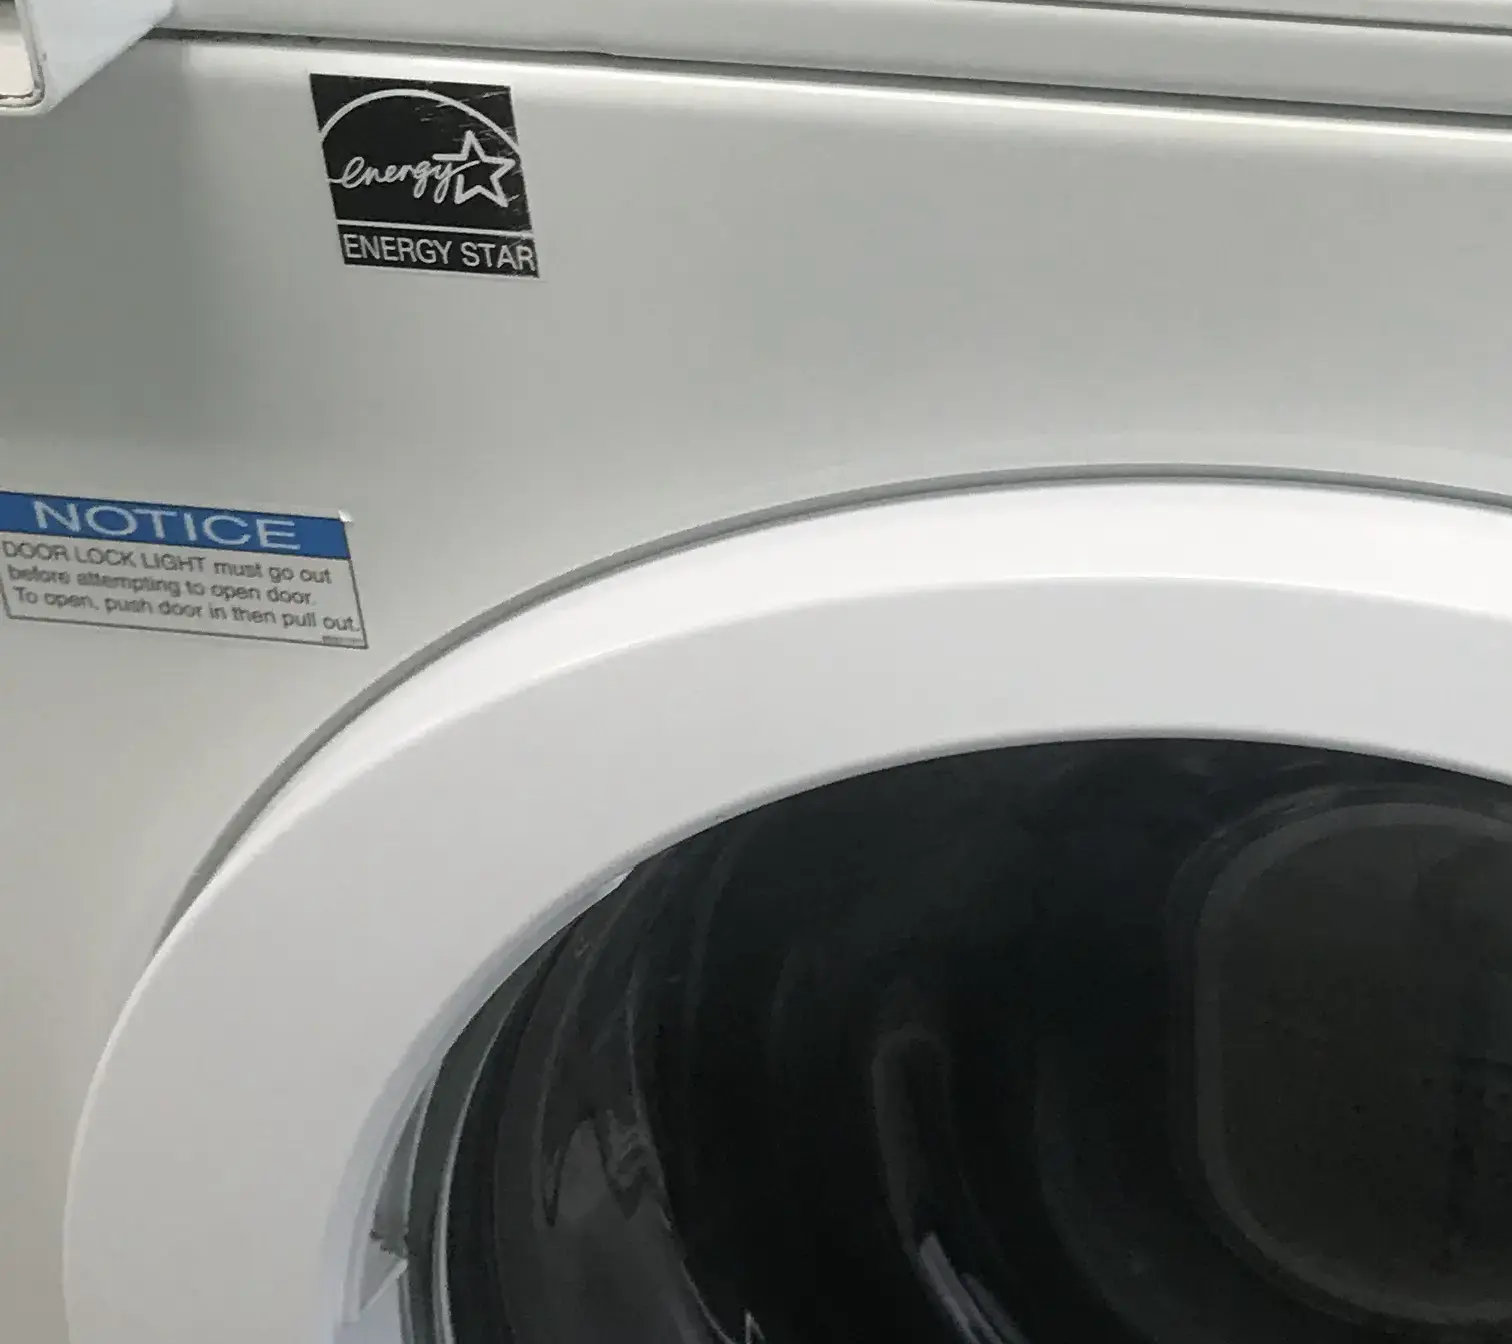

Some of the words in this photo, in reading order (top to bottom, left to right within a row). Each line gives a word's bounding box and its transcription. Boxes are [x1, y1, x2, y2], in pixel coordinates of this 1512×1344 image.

[326, 156, 481, 203] energy
[343, 234, 452, 264] ENERGY
[461, 241, 536, 271] STAR
[32, 500, 301, 550] NOTICE
[2, 540, 70, 562] DOOR
[74, 545, 136, 568] LOCK
[141, 552, 206, 572] LIGHT
[214, 561, 263, 578] must
[268, 565, 294, 583] go
[300, 568, 332, 584] out
[7, 564, 71, 585] before
[76, 571, 181, 598] attempting
[185, 580, 206, 596] to
[210, 582, 262, 601] open
[266, 586, 317, 605] door.
[13, 586, 38, 604] To
[104, 597, 153, 615] push
[158, 600, 203, 618] door
[208, 605, 228, 621] in
[231, 605, 276, 624] then
[281, 611, 317, 629] pull
[322, 615, 361, 632] out.
